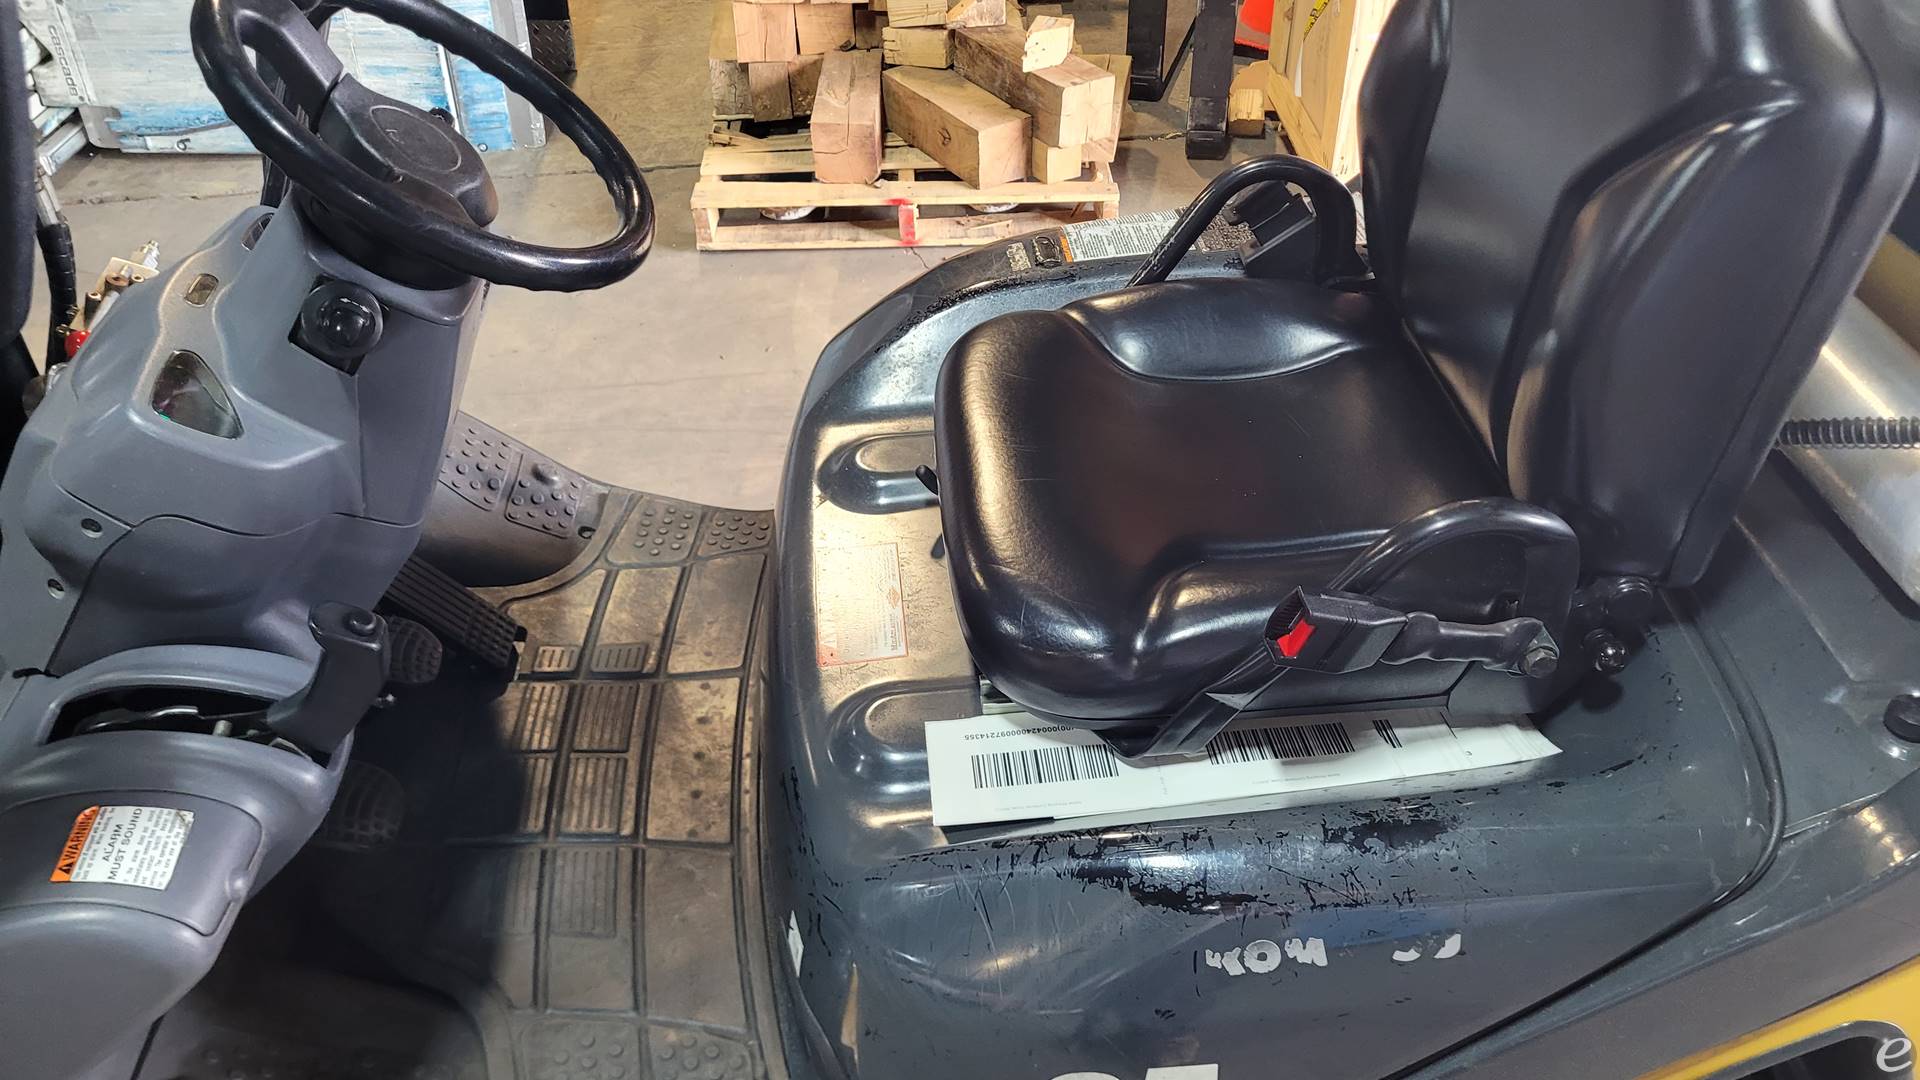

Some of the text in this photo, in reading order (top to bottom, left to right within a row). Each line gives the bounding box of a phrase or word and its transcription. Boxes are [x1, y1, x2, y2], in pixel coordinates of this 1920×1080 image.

[50, 25, 78, 97] cascade
[63, 808, 96, 860] WARNING
[100, 822, 124, 862] ALARM
[107, 847, 127, 880] MUST
[120, 807, 143, 845] SOUND
